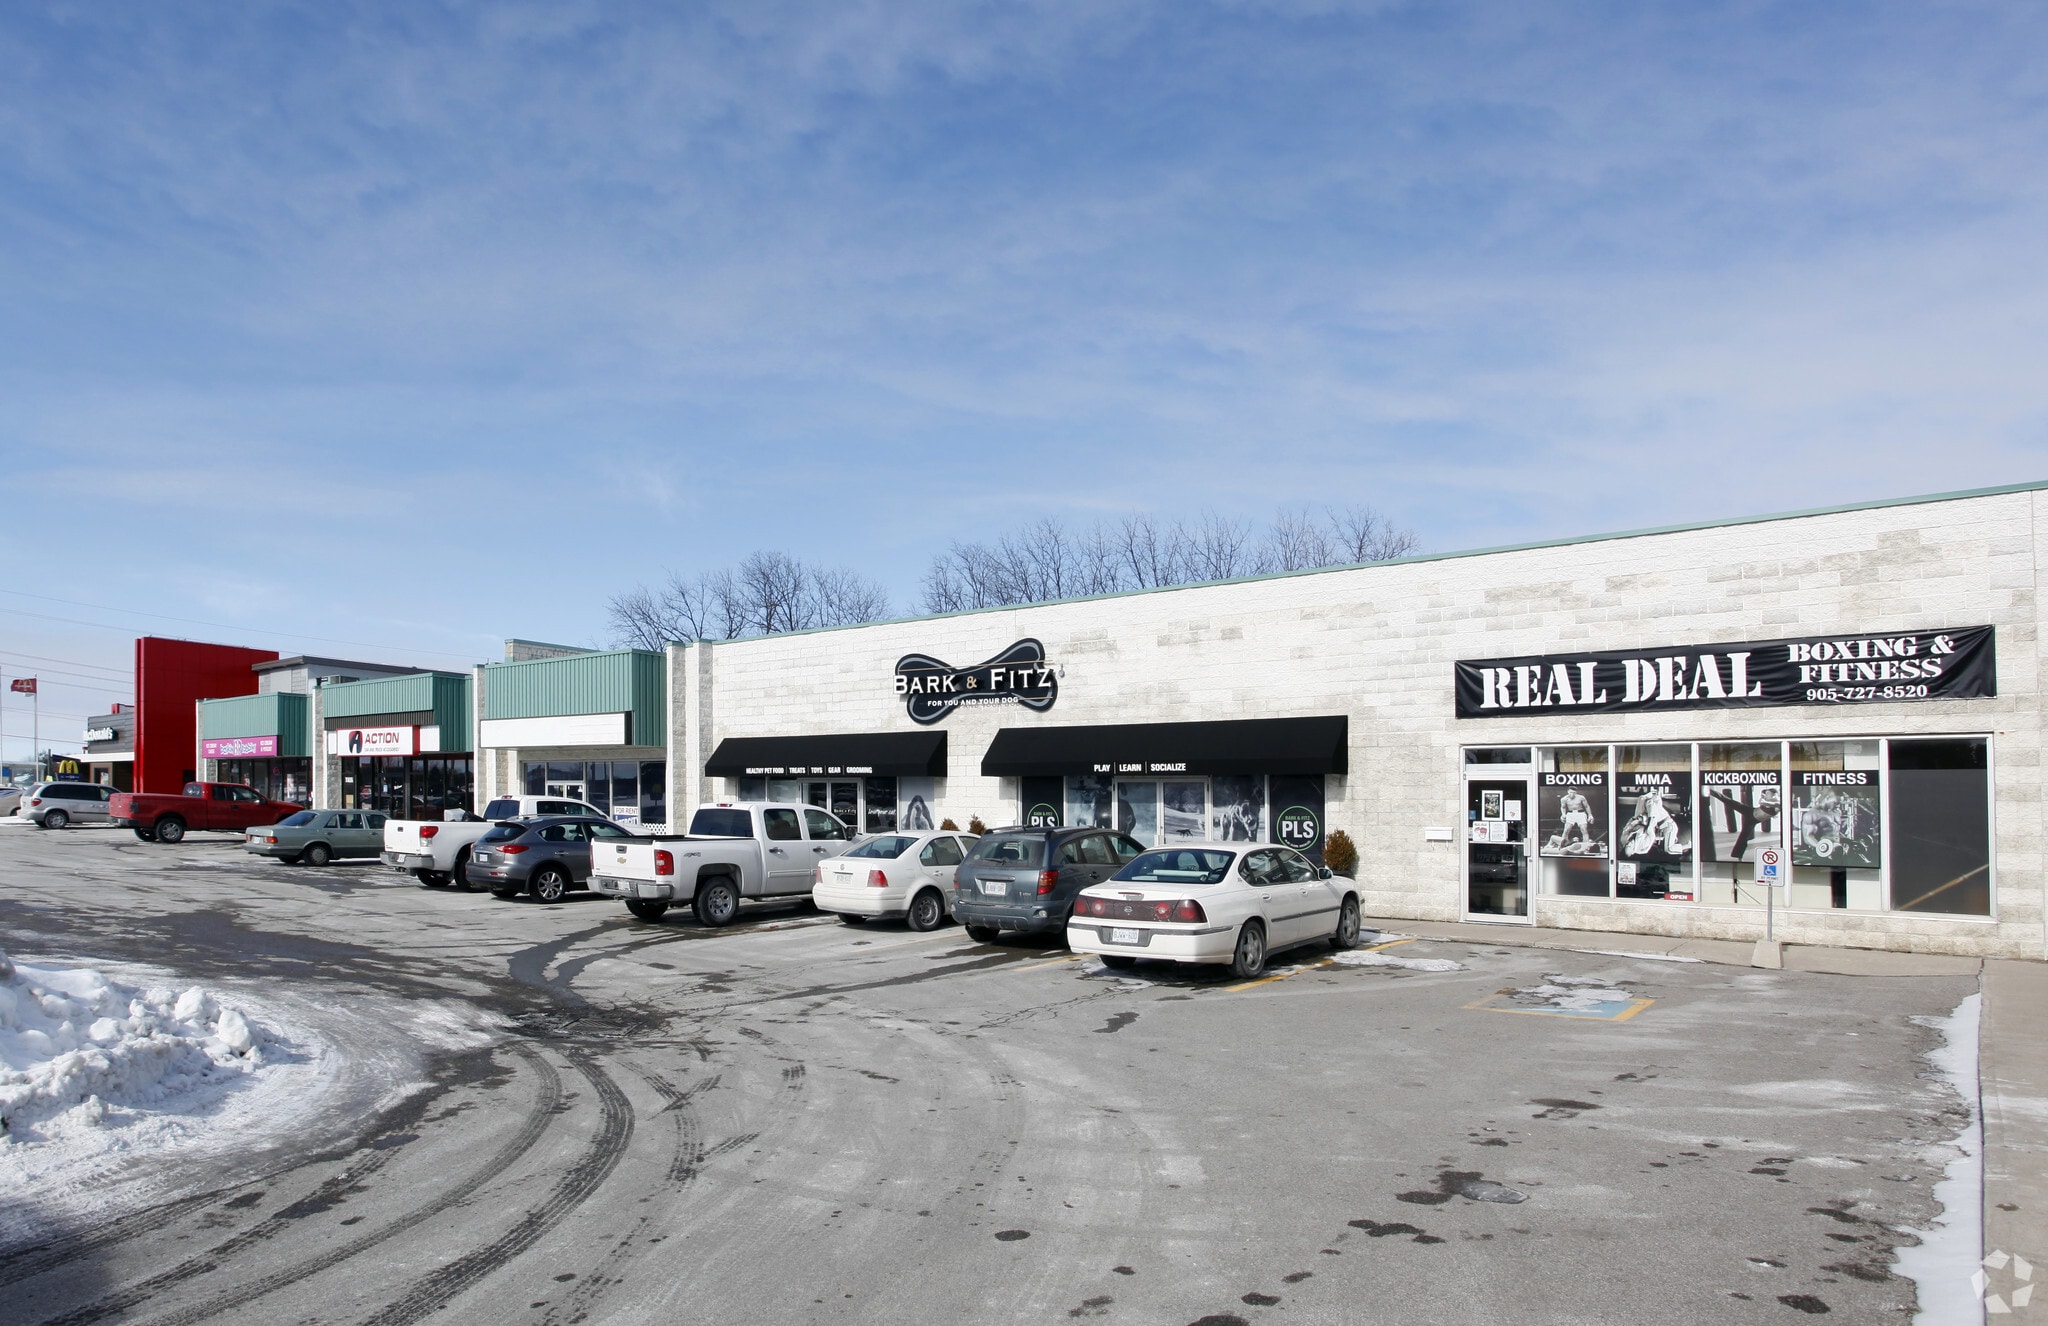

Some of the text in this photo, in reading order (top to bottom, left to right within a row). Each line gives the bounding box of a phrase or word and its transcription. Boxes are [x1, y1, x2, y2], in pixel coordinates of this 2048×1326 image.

[1787, 635, 1955, 662] BOXING &
[1799, 658, 1942, 683] FITNESS
[893, 667, 1051, 694] BARK & FITZ
[1479, 652, 1762, 709] REAL DEAL
[1806, 685, 1928, 701] 905-727-8520
[364, 732, 400, 744] ACTION
[846, 766, 873, 774] GROOMING
[1093, 763, 1187, 772] PLAY LEARN SOCIALIZE
[1546, 773, 1602, 785] BOXING
[1635, 773, 1672, 785] MMA
[1704, 772, 1777, 784] KICKBOXING
[1803, 773, 1867, 785] FITNESS
[1282, 820, 1314, 839] PLS
